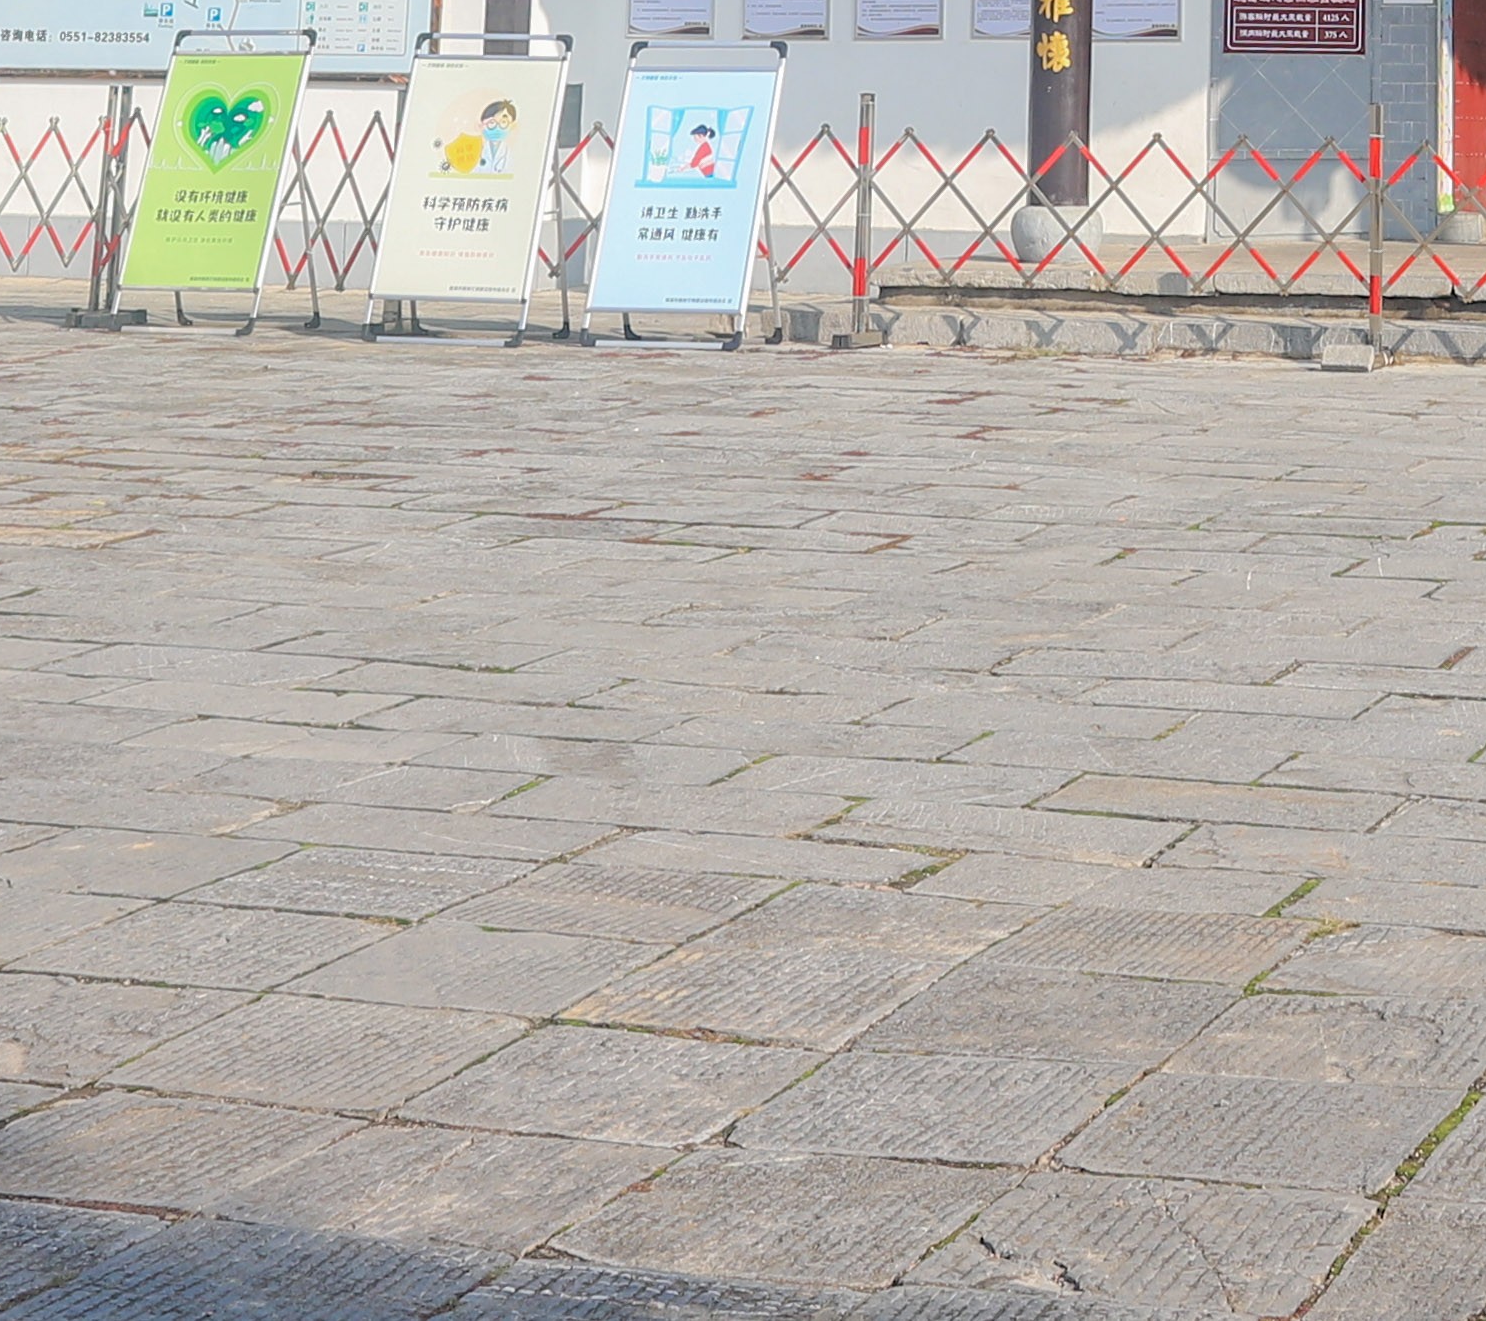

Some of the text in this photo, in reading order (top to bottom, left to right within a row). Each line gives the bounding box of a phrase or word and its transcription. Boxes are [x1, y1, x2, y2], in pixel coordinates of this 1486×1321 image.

[60, 31, 150, 44] 0551-82383554
[174, 190, 249, 203] 没有环境健康
[423, 196, 509, 213] 科学预防疾病
[155, 208, 258, 223] 就没有人类的健康
[684, 207, 723, 220] 勤洗手
[434, 217, 490, 233] 守护健康
